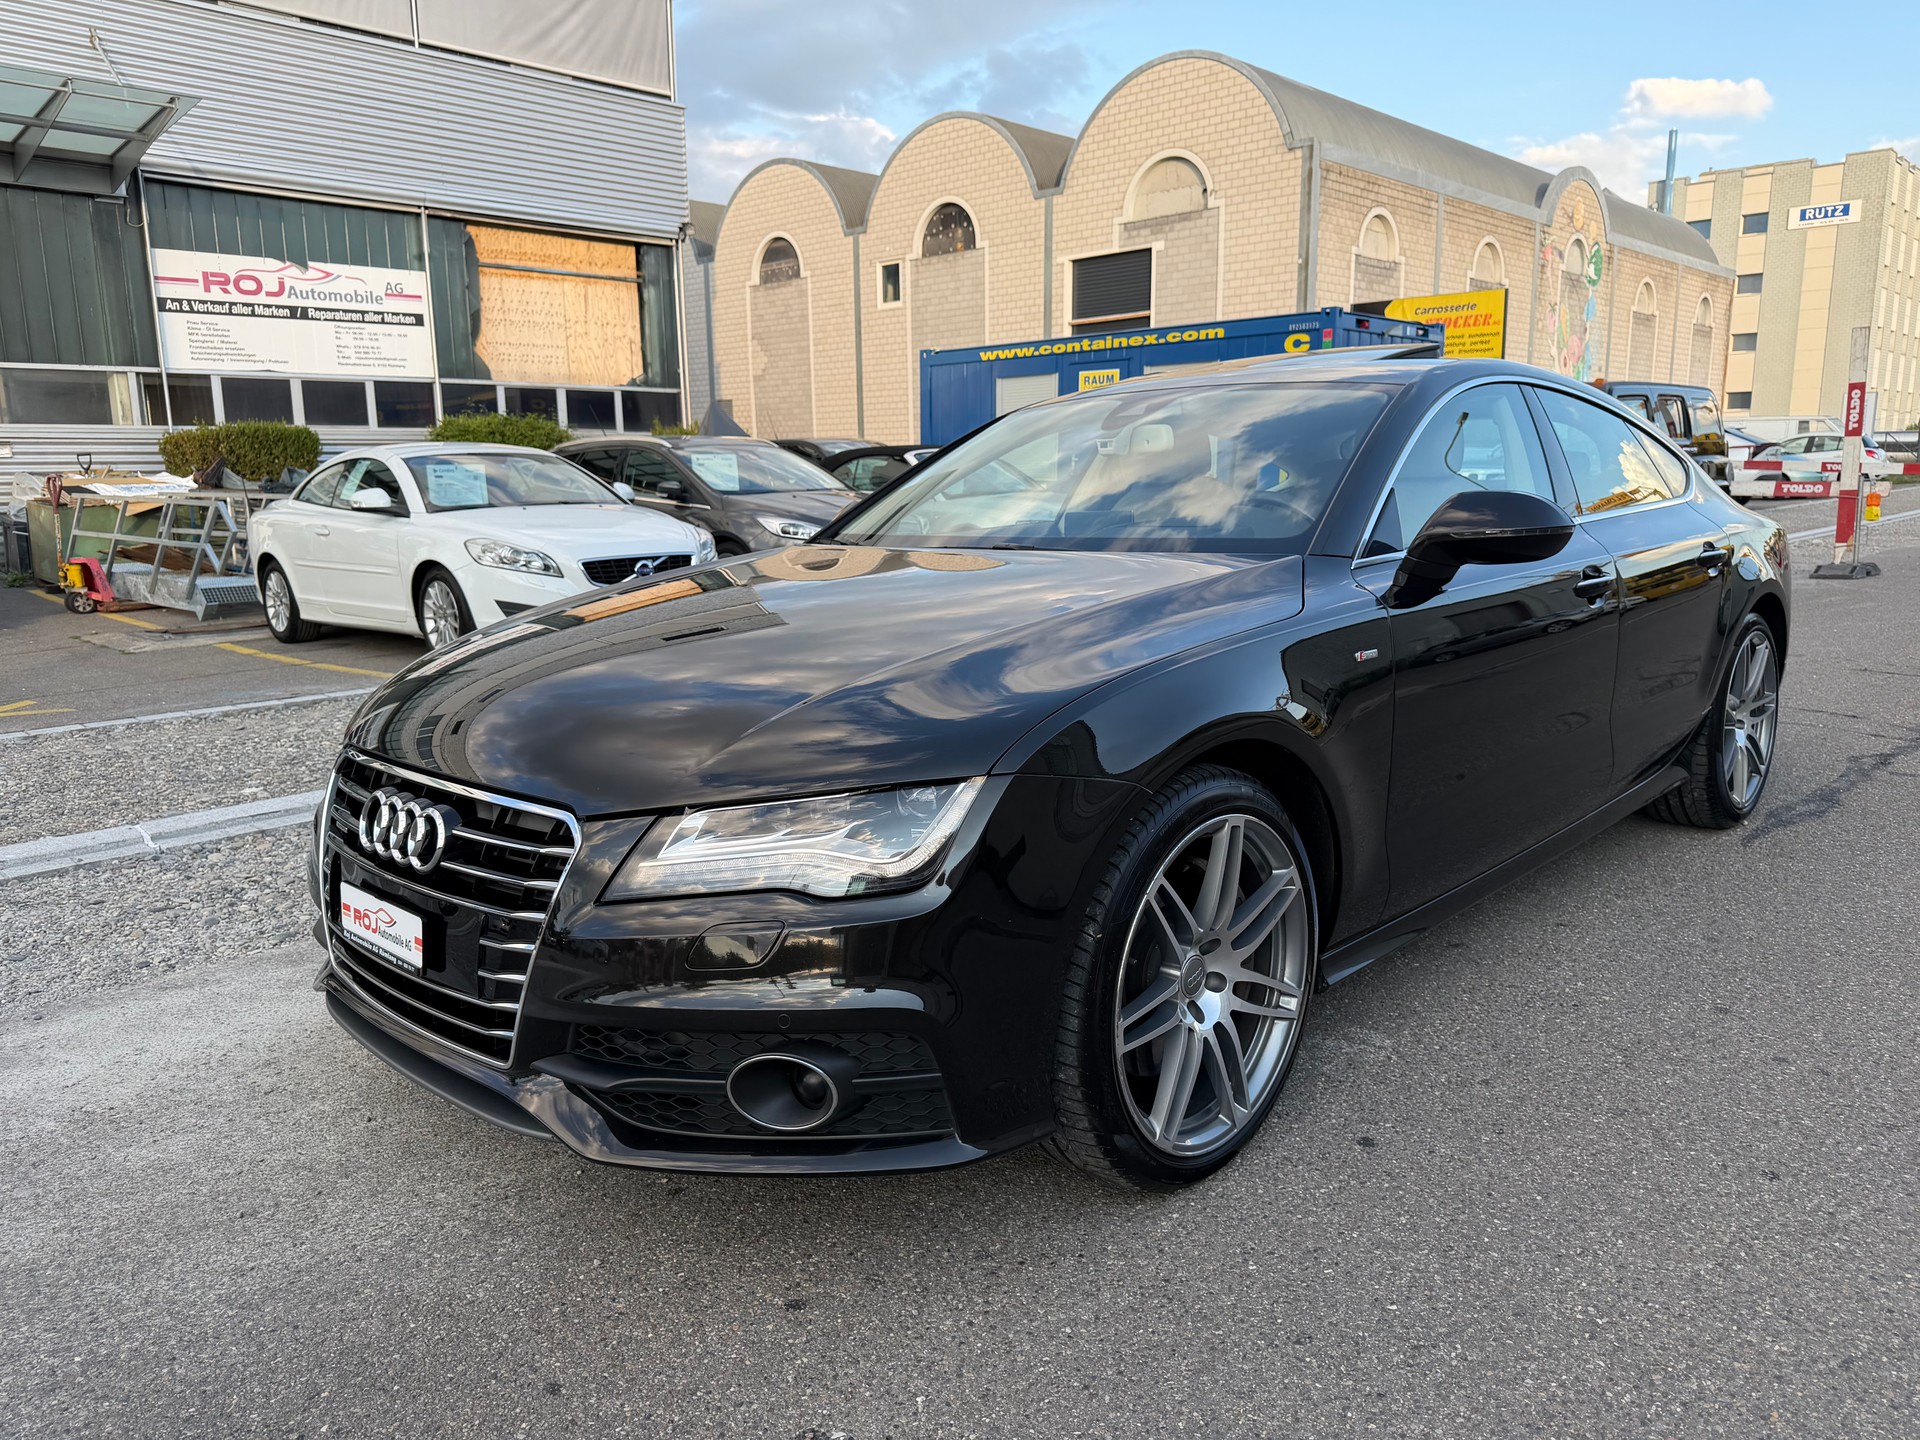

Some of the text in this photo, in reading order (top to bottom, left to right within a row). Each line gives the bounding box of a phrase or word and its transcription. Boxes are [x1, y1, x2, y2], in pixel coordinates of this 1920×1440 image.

[1805, 205, 1844, 220] RUTZ
[201, 271, 404, 305] ROJ Automobile AG
[165, 299, 416, 324] An & Verkauf aller Marken / Reparaturen aller Marken
[1414, 302, 1477, 315] Carrosserie
[979, 327, 1225, 361] www.containex.com
[1284, 333, 1310, 353] C
[1083, 374, 1114, 386] RAUM
[1848, 389, 1861, 431] TOLDO
[1825, 463, 1842, 471] TOL
[1781, 484, 1824, 493] TOLDO
[353, 907, 412, 952] ROJ Automobile AG
[351, 933, 373, 950] Automobile
